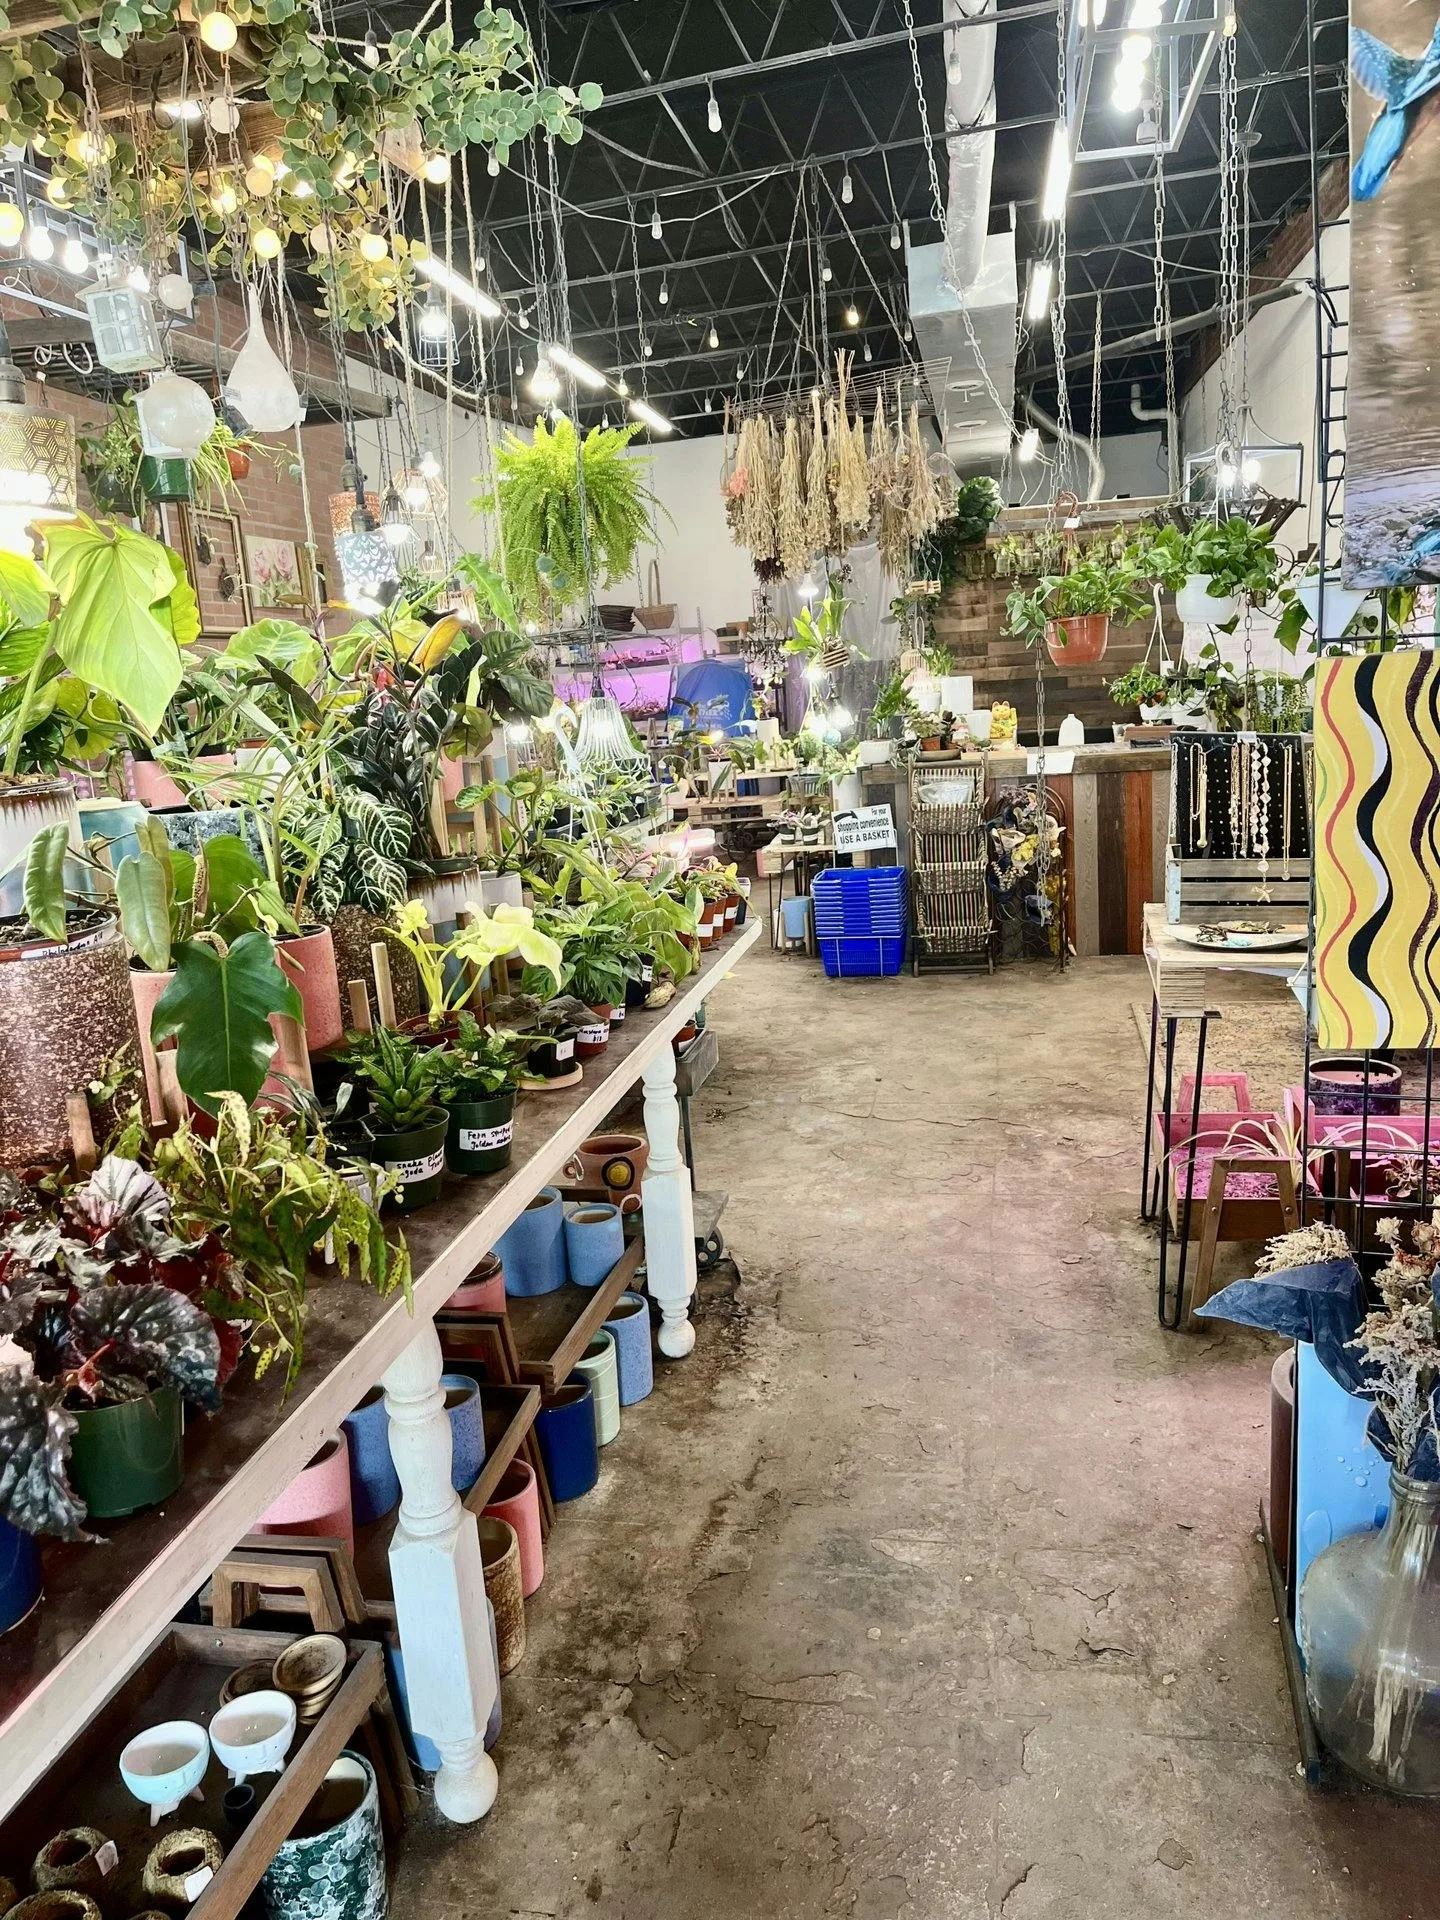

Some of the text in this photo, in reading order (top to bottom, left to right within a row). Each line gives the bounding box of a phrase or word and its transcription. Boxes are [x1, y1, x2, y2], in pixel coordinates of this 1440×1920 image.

[860, 817, 889, 829] convenience
[840, 829, 890, 845] USE A BASKET
